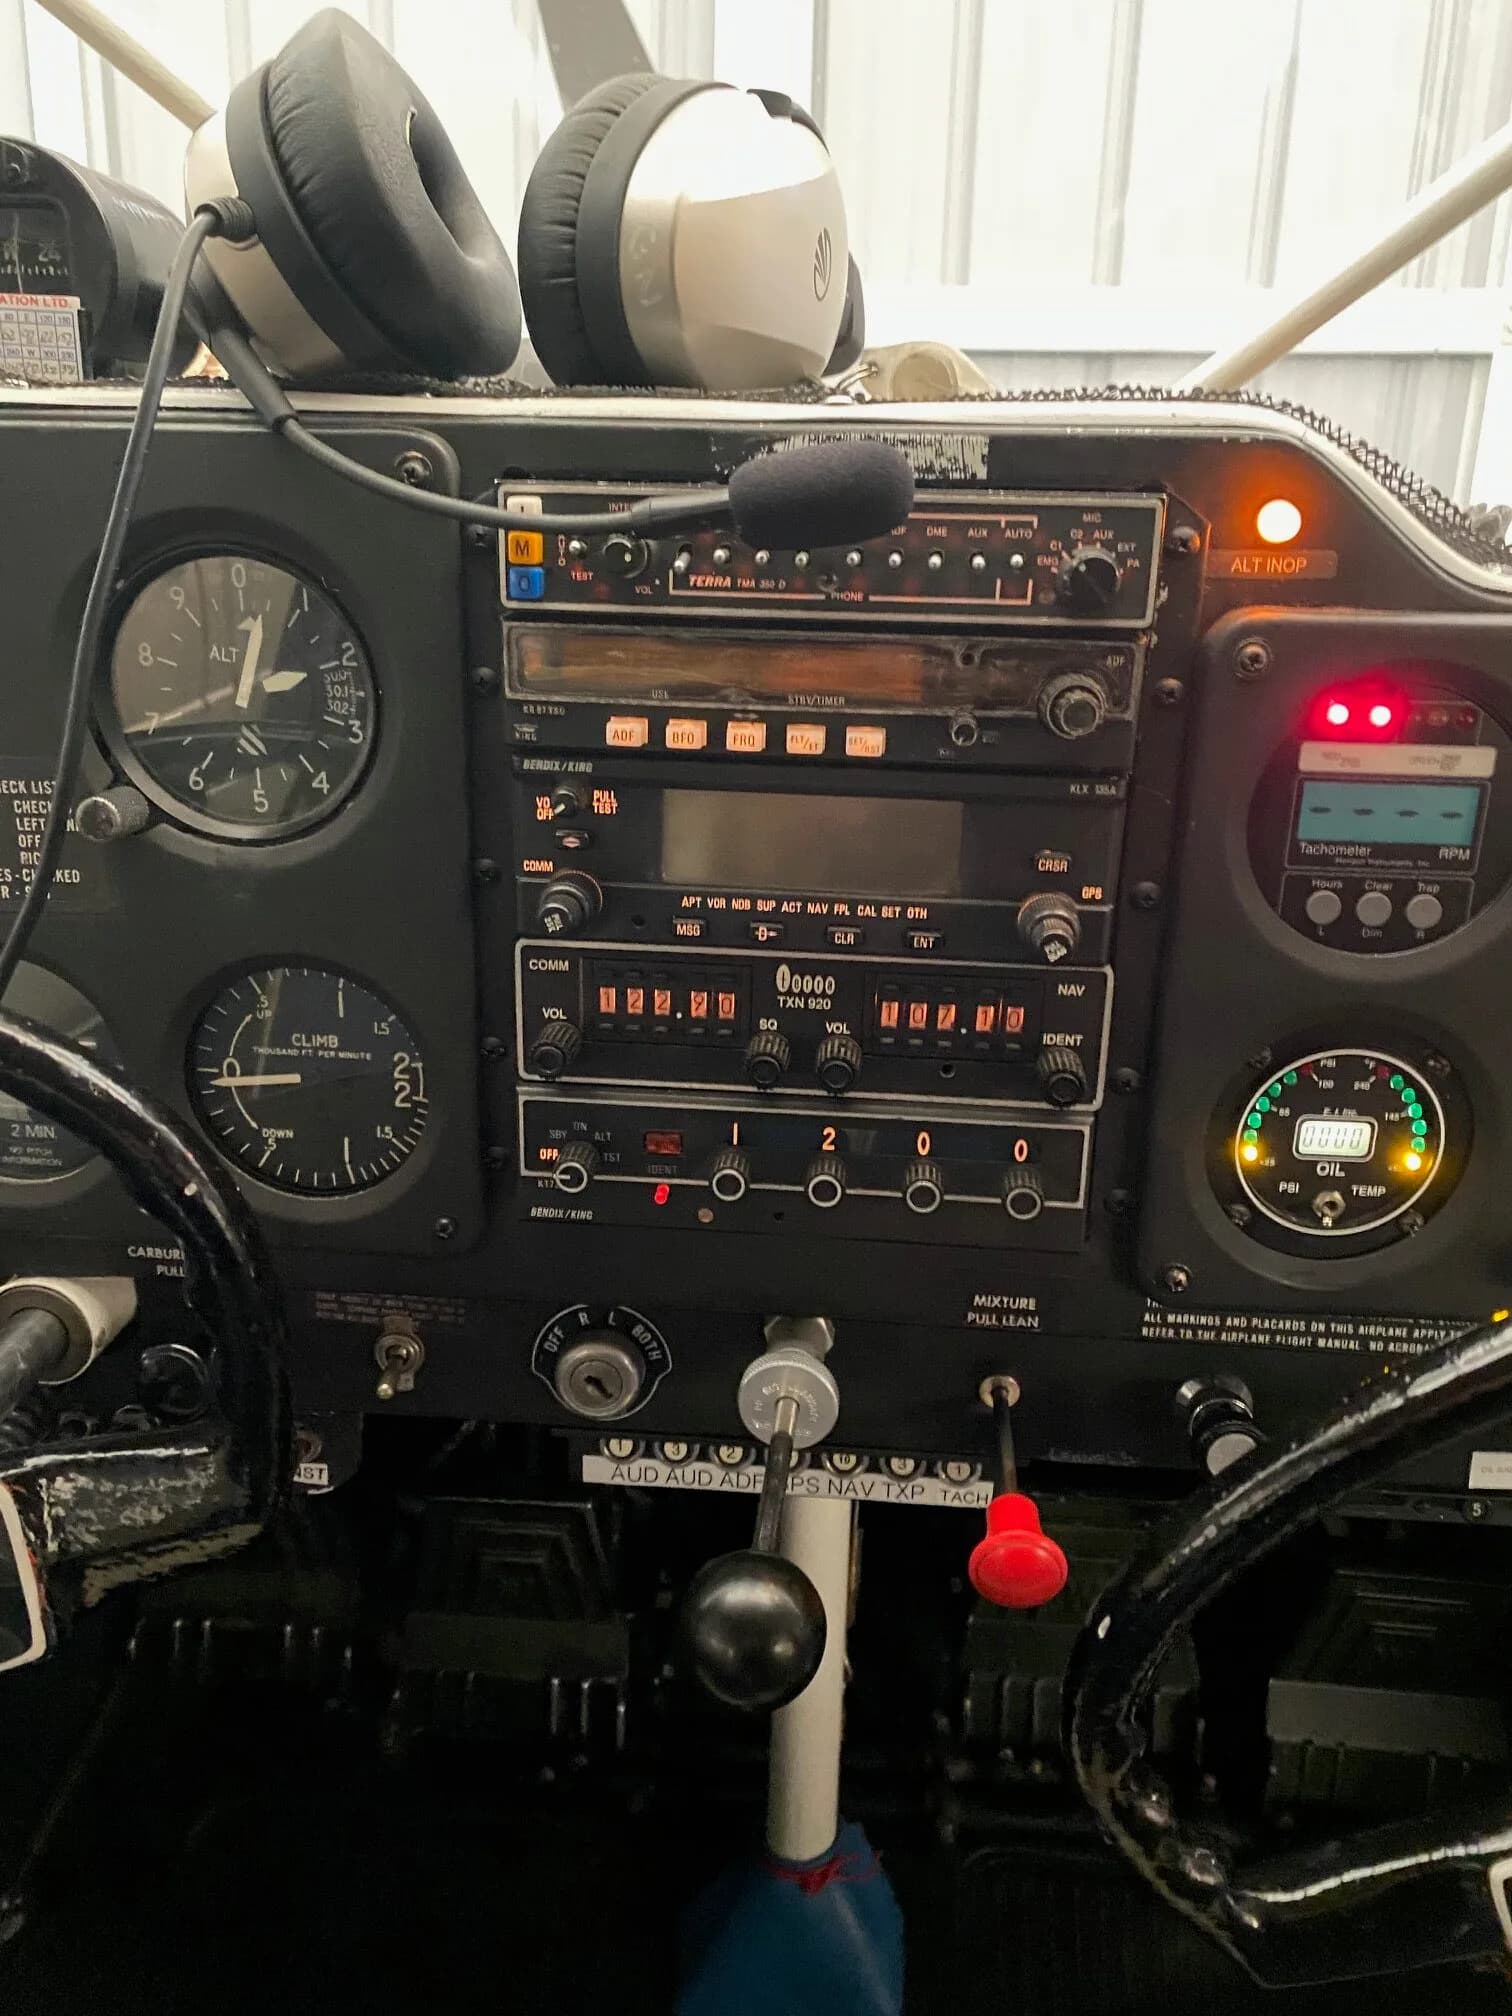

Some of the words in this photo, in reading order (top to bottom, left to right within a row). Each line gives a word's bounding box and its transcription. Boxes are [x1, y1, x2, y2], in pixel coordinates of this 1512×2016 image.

[43, 297, 68, 308] LTD
[1082, 512, 1102, 523] MIC
[926, 527, 947, 538] DME
[967, 528, 988, 539] AUX
[1005, 528, 1033, 540] AUTO
[1093, 529, 1114, 540] AUX
[516, 540, 529, 557] M
[1117, 542, 1136, 553] EXT
[1127, 558, 1140, 568] PA
[1231, 557, 1260, 573] ALT
[1266, 556, 1308, 574] INOP
[231, 563, 246, 588] 0
[571, 570, 594, 581] TEST
[689, 574, 731, 588] TERRA
[635, 584, 653, 594] VOL
[169, 586, 185, 610] 9
[137, 643, 153, 666] 8
[209, 646, 240, 663] ALT
[342, 642, 358, 667] 2
[1106, 656, 1125, 667] ADF
[348, 720, 363, 744] 3
[612, 729, 634, 743] ADF
[672, 732, 694, 745] BFO
[733, 734, 755, 747] FRQ
[523, 759, 593, 773] BENDIX/KING
[188, 767, 204, 790] 6
[311, 771, 330, 794] 4
[253, 791, 269, 812] 5
[593, 790, 616, 803] PULL
[592, 802, 618, 814] TEST
[16, 817, 46, 831] LEFT
[18, 835, 40, 848] OFF
[1300, 843, 1372, 857] Tachometer
[1439, 846, 1471, 861] RPM
[523, 860, 553, 872] COMM
[1038, 859, 1068, 872] CRSR
[1312, 879, 1343, 889] Hours
[1417, 882, 1440, 894] Trap
[1081, 886, 1102, 899] GPS
[681, 896, 702, 908] APT
[707, 897, 726, 909] VOR
[731, 898, 751, 910] NDB
[756, 899, 776, 912] SUP
[781, 901, 802, 913] ACT
[807, 901, 828, 914] NAV
[834, 902, 850, 915] FPL
[857, 904, 878, 917] CAL
[881, 905, 902, 918] SET
[907, 906, 928, 919] OTH
[676, 924, 701, 936] MSG
[834, 931, 855, 945] CLR
[913, 936, 935, 949] ENT
[529, 959, 569, 971] COMM
[1057, 983, 1086, 997] NAV
[777, 995, 804, 1008] TXN
[808, 997, 831, 1010] 920
[257, 1009, 272, 1019] UP
[542, 1007, 567, 1019] VOL
[759, 1018, 778, 1030] SQ
[825, 1020, 851, 1034] VOL
[291, 1033, 338, 1048] CLIMB
[1042, 1033, 1083, 1047] IDENT
[338, 1051, 372, 1061] MINUTE
[393, 1052, 410, 1079] 2
[395, 1081, 412, 1108] 2
[10, 1124, 20, 1137] 2
[262, 1127, 294, 1139] DOWN
[573, 1121, 588, 1131] ON
[594, 1131, 612, 1141] ALT
[821, 1127, 836, 1151] 2
[916, 1131, 931, 1156] 0
[1013, 1139, 1028, 1162] 0
[539, 1148, 559, 1160] OFF
[1316, 1161, 1345, 1177] OIL
[1279, 1182, 1299, 1194] PSI
[1352, 1185, 1386, 1197] TEMP
[530, 1206, 593, 1220] BENDIX/KING
[973, 1294, 1037, 1310] MIXTURE
[578, 1311, 590, 1326] R
[608, 1311, 616, 1326] L
[967, 1311, 999, 1326] PULL
[1002, 1314, 1039, 1328] LEAN
[1144, 1312, 1162, 1323] ALL
[1167, 1312, 1221, 1327] MARKINGS
[1226, 1316, 1247, 1327] AND
[1252, 1317, 1306, 1332] PLACARDS
[1310, 1322, 1325, 1333] ON
[1331, 1322, 1353, 1335] THIS
[1358, 1324, 1408, 1338] AIRPLANE
[1413, 1328, 1446, 1340] APPLY
[543, 1325, 564, 1352] OFF
[631, 1324, 662, 1360] BOTH
[1199, 1330, 1216, 1341] THE
[1221, 1331, 1270, 1345] AIRPLANE
[1276, 1334, 1312, 1347] FLIGHT
[1370, 1341, 1384, 1352] NO
[611, 1463, 659, 1482] AUD
[666, 1467, 713, 1487] AUD
[719, 1471, 764, 1490] ADF
[828, 1479, 876, 1496] NAV
[881, 1482, 925, 1500] TXP
[942, 1490, 989, 1505] TACH
[1472, 1502, 1482, 1517] 5
